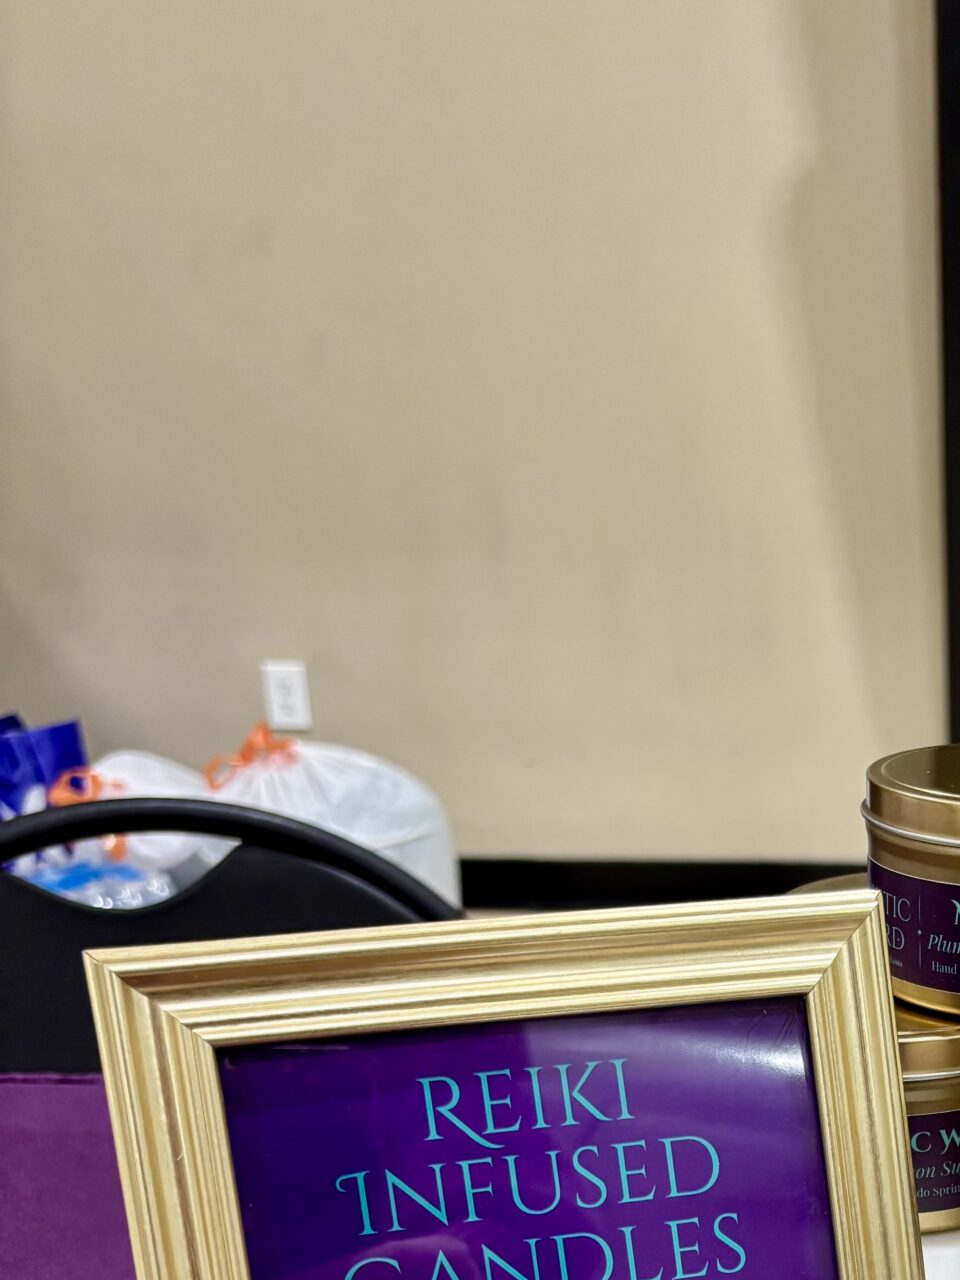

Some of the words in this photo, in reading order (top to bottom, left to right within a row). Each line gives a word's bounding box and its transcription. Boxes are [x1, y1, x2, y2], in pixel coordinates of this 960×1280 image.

[883, 890, 912, 922] TIC
[885, 923, 906, 951] RD
[931, 960, 958, 975] Hand
[415, 1057, 637, 1149] REIKI
[335, 1135, 720, 1237] INFUSED
